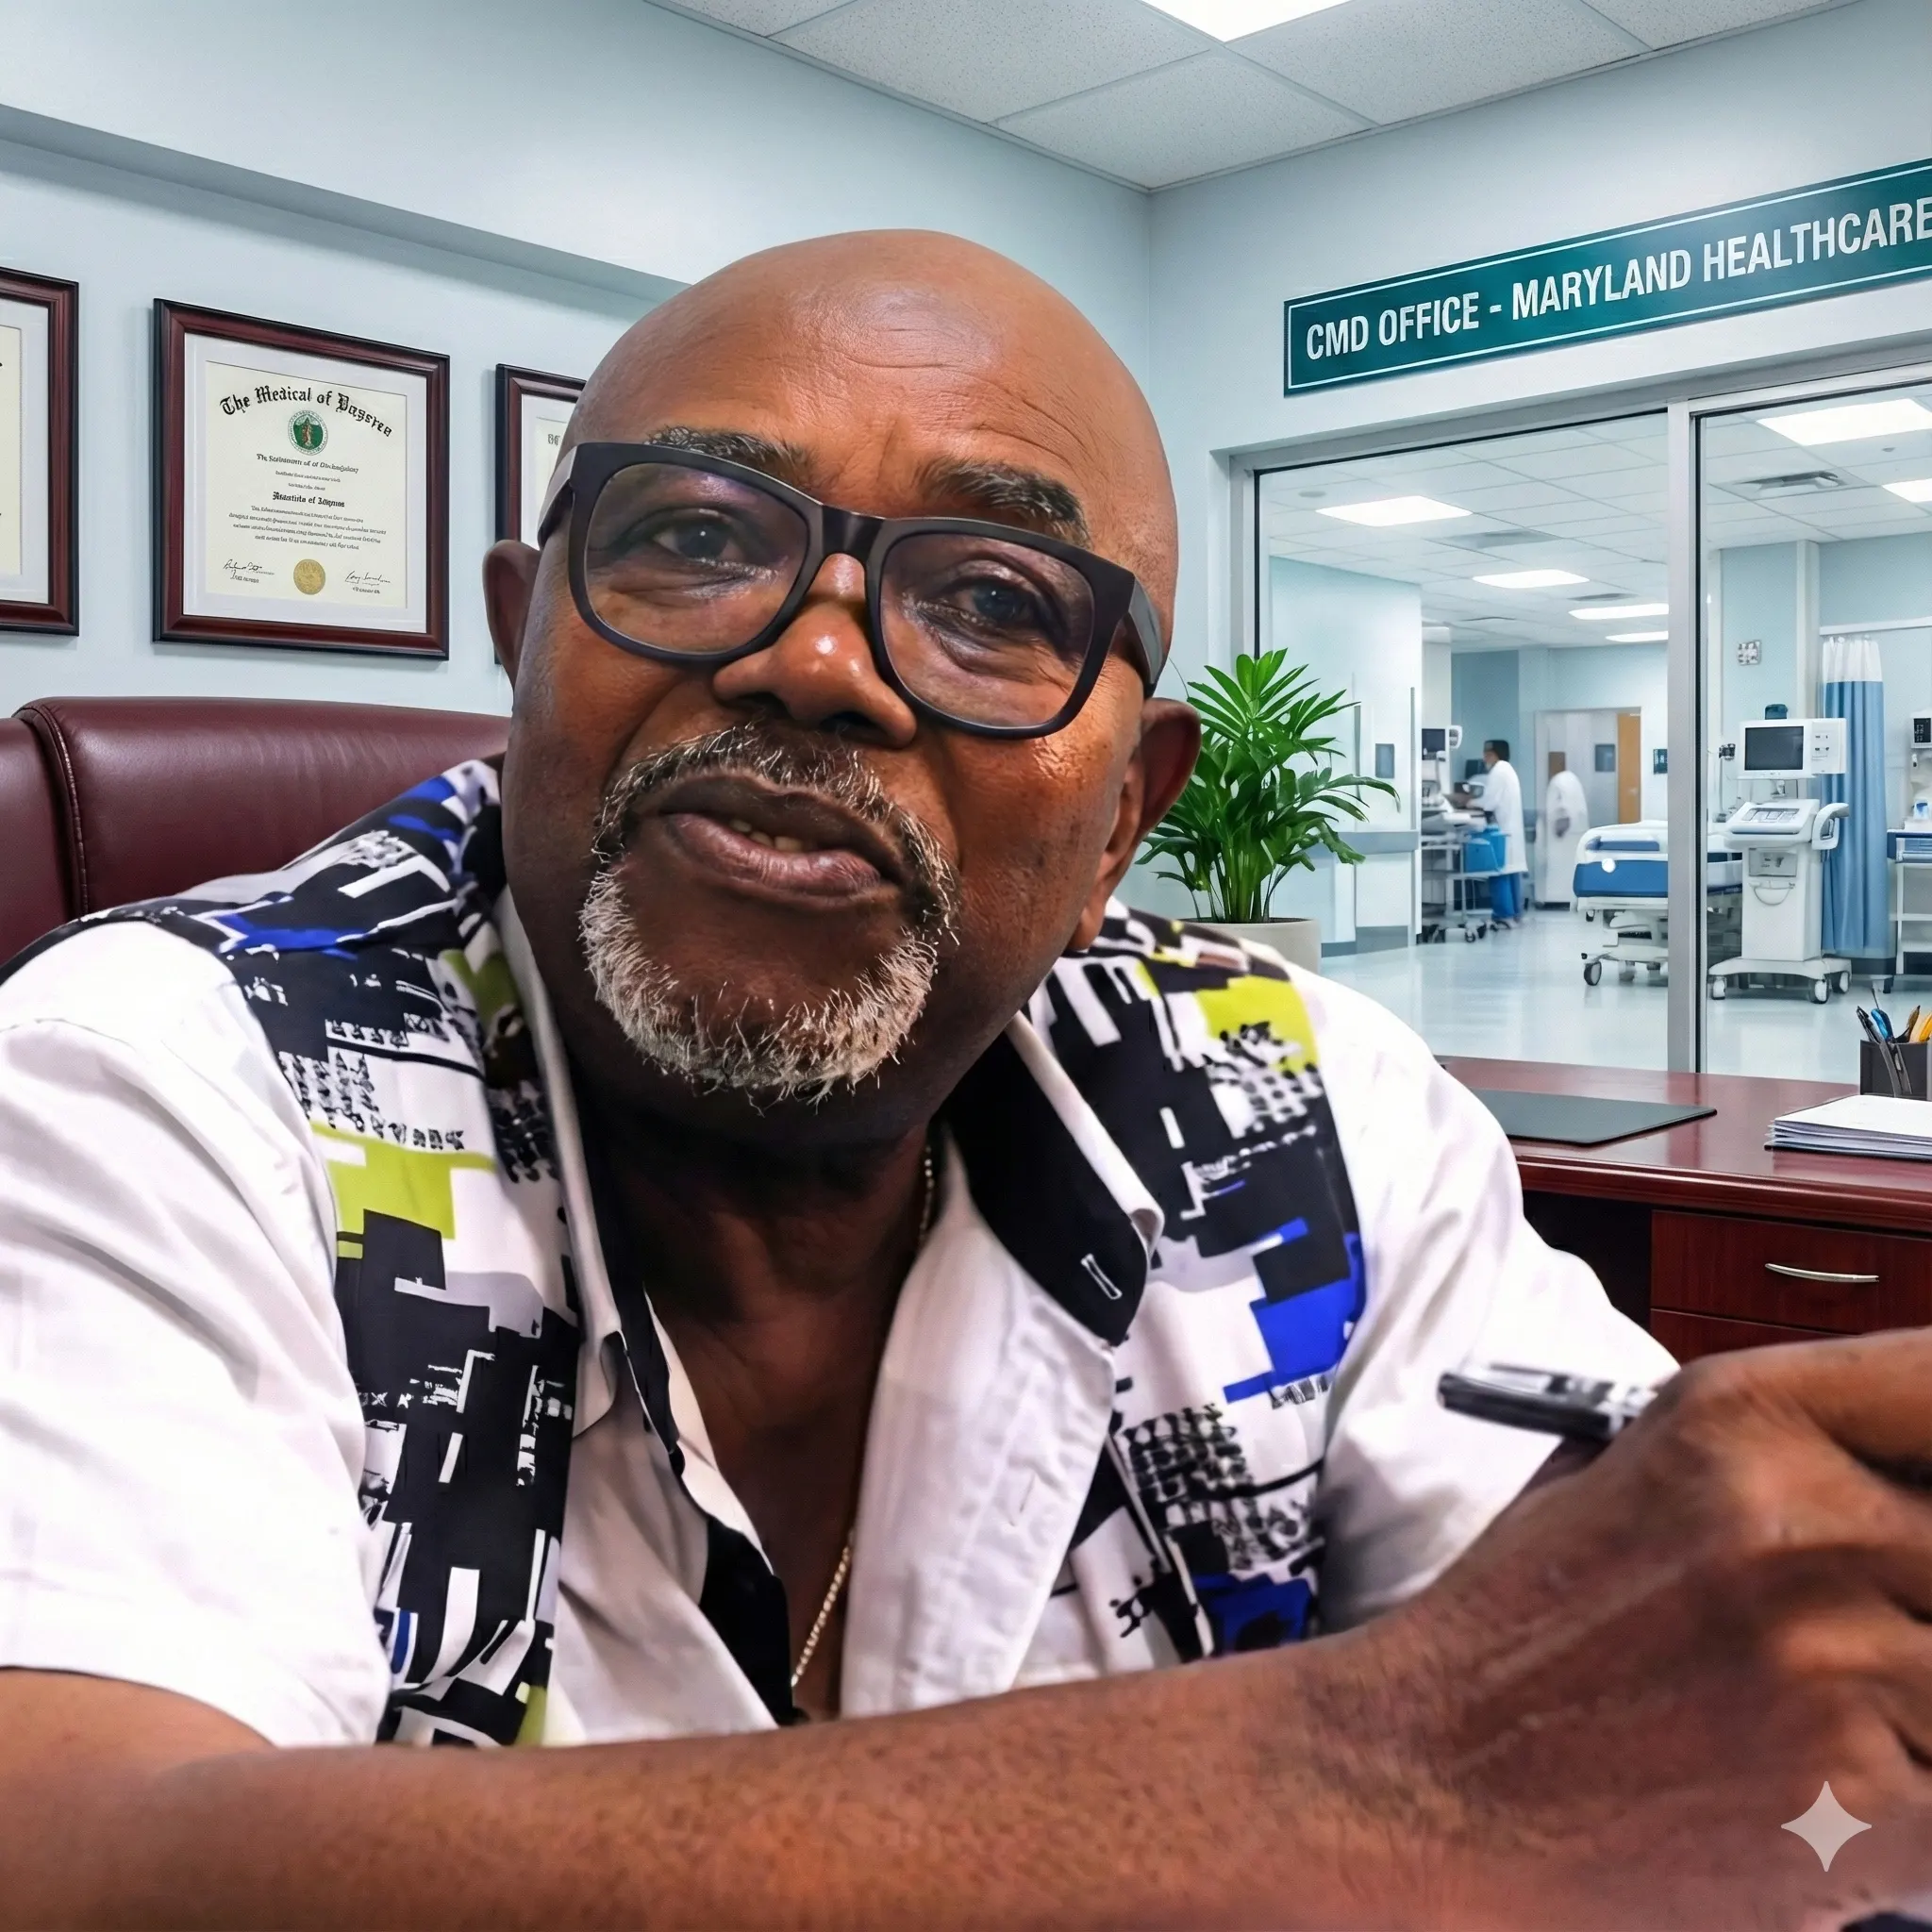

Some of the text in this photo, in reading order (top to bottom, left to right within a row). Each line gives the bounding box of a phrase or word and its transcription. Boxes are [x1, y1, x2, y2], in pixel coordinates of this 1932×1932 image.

[1307, 196, 1932, 360] CMD OFFICE - MARYLAND HEALTHCARE
[220, 394, 251, 415] The
[255, 385, 311, 404] Medical
[316, 391, 333, 406] of
